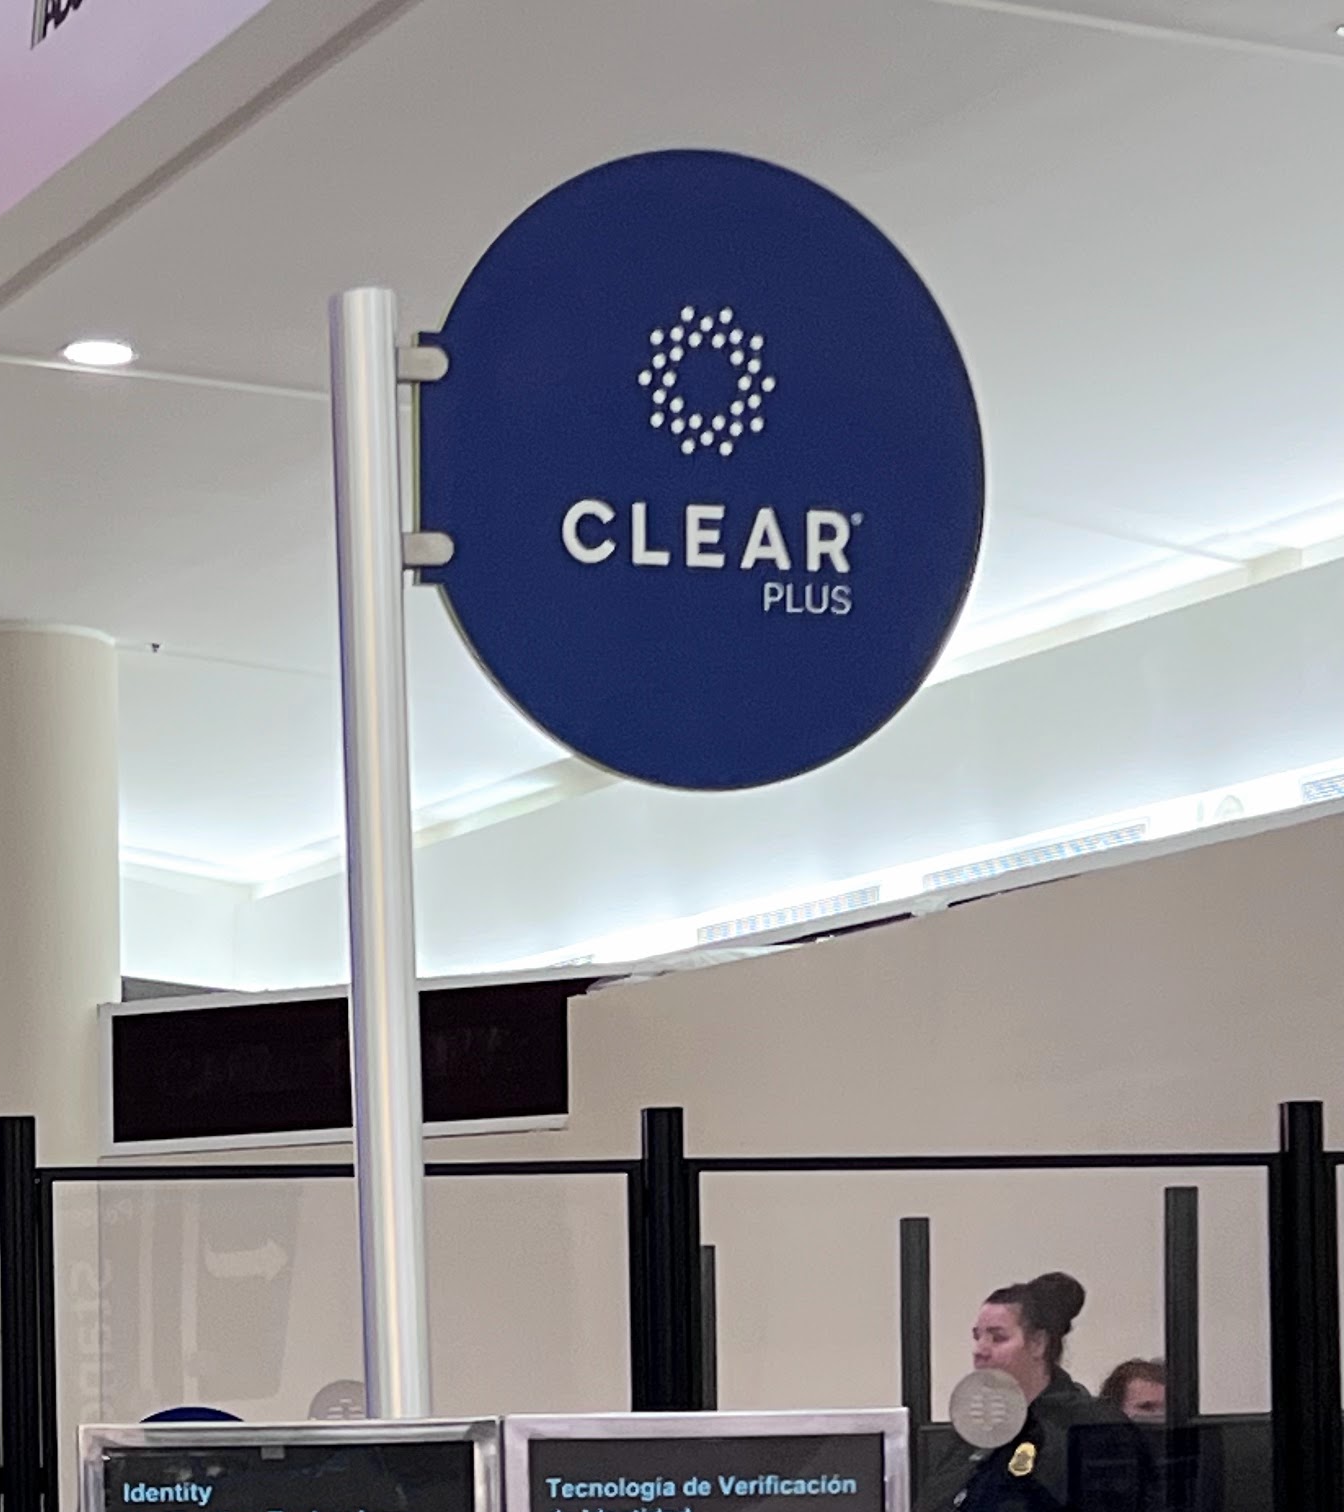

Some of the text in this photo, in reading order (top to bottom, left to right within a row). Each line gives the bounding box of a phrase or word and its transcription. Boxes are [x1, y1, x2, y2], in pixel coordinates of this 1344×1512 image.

[561, 499, 851, 573] CLEAR
[762, 581, 852, 615] PLUS
[123, 1482, 213, 1506] Identity
[682, 1477, 712, 1496] de
[718, 1474, 858, 1496] Verificación
